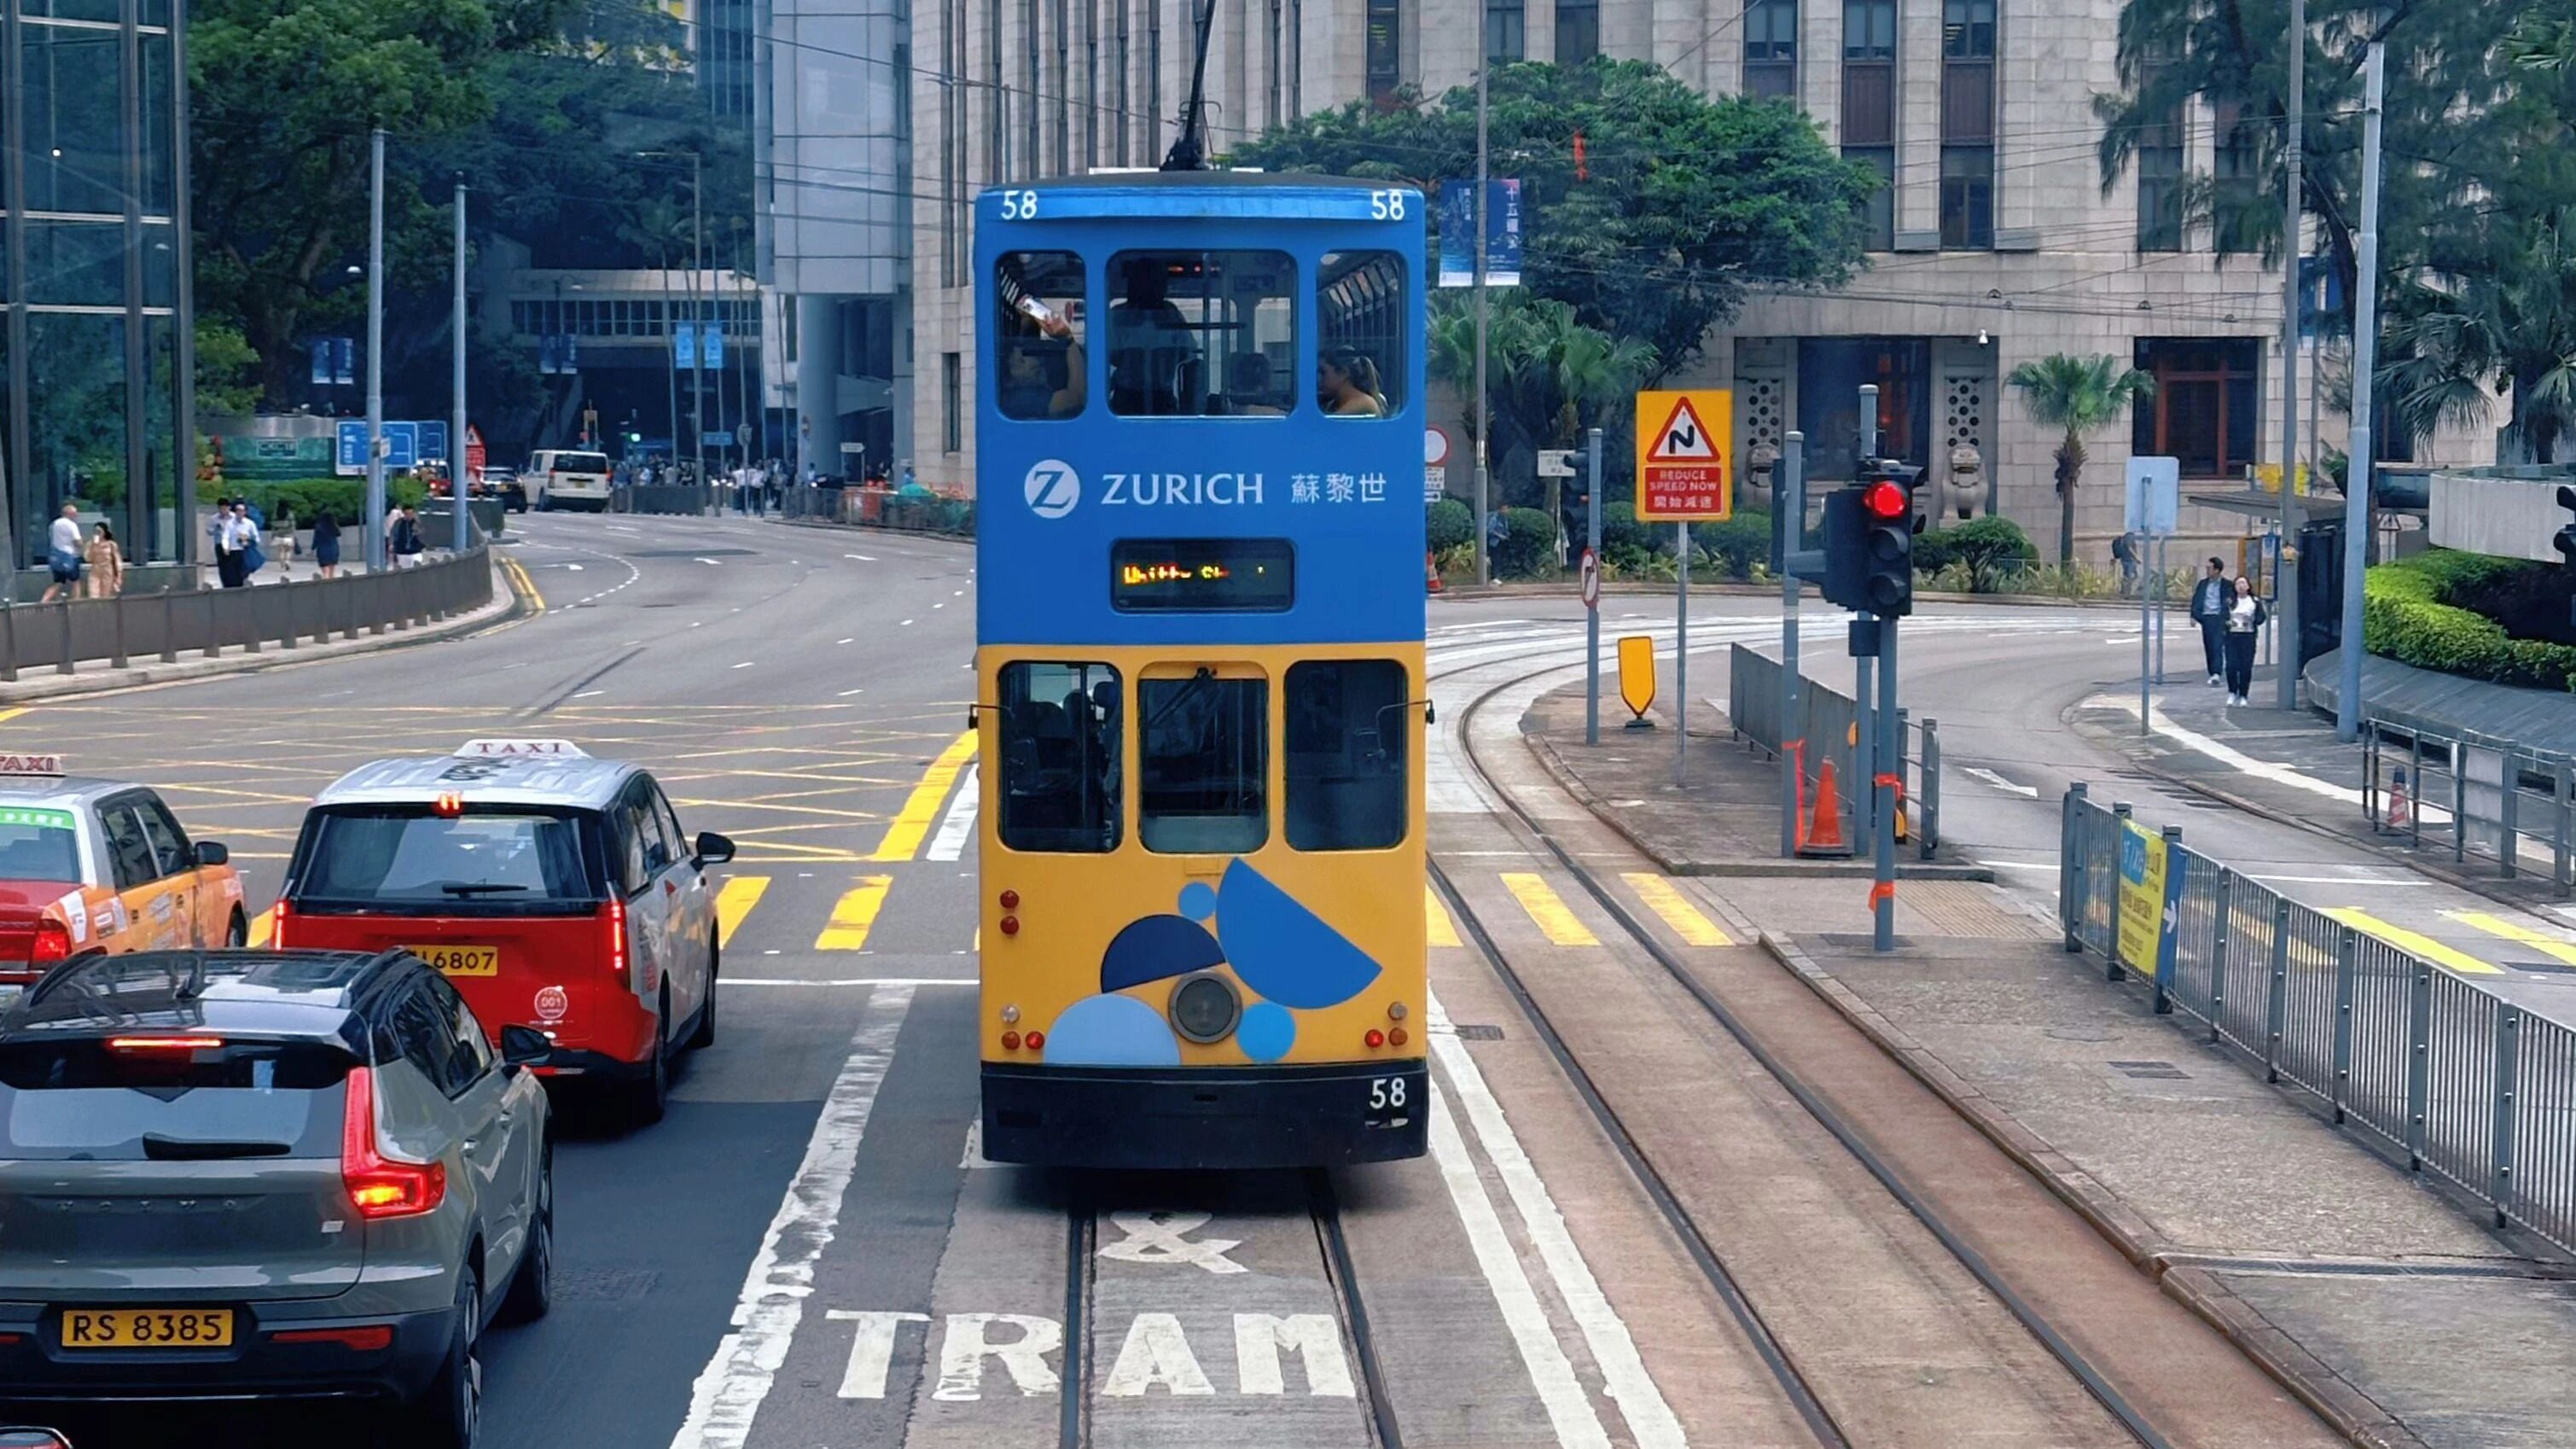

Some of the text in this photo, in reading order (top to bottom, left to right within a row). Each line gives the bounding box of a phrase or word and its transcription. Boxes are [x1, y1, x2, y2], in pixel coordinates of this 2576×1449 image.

[1000, 189, 1038, 220] 58
[1371, 190, 1405, 221] 58
[1101, 473, 1264, 506] ZURICH
[1290, 472, 1387, 504] 蘇黎世
[1649, 481, 1718, 492] SPEED NOW
[1660, 470, 1707, 480] REDUCE
[476, 742, 562, 754] TAXI
[433, 951, 496, 970] 6807
[1369, 1076, 1407, 1110] 58
[73, 1314, 223, 1342] RS 8385
[825, 1309, 1357, 1401] TRAM
